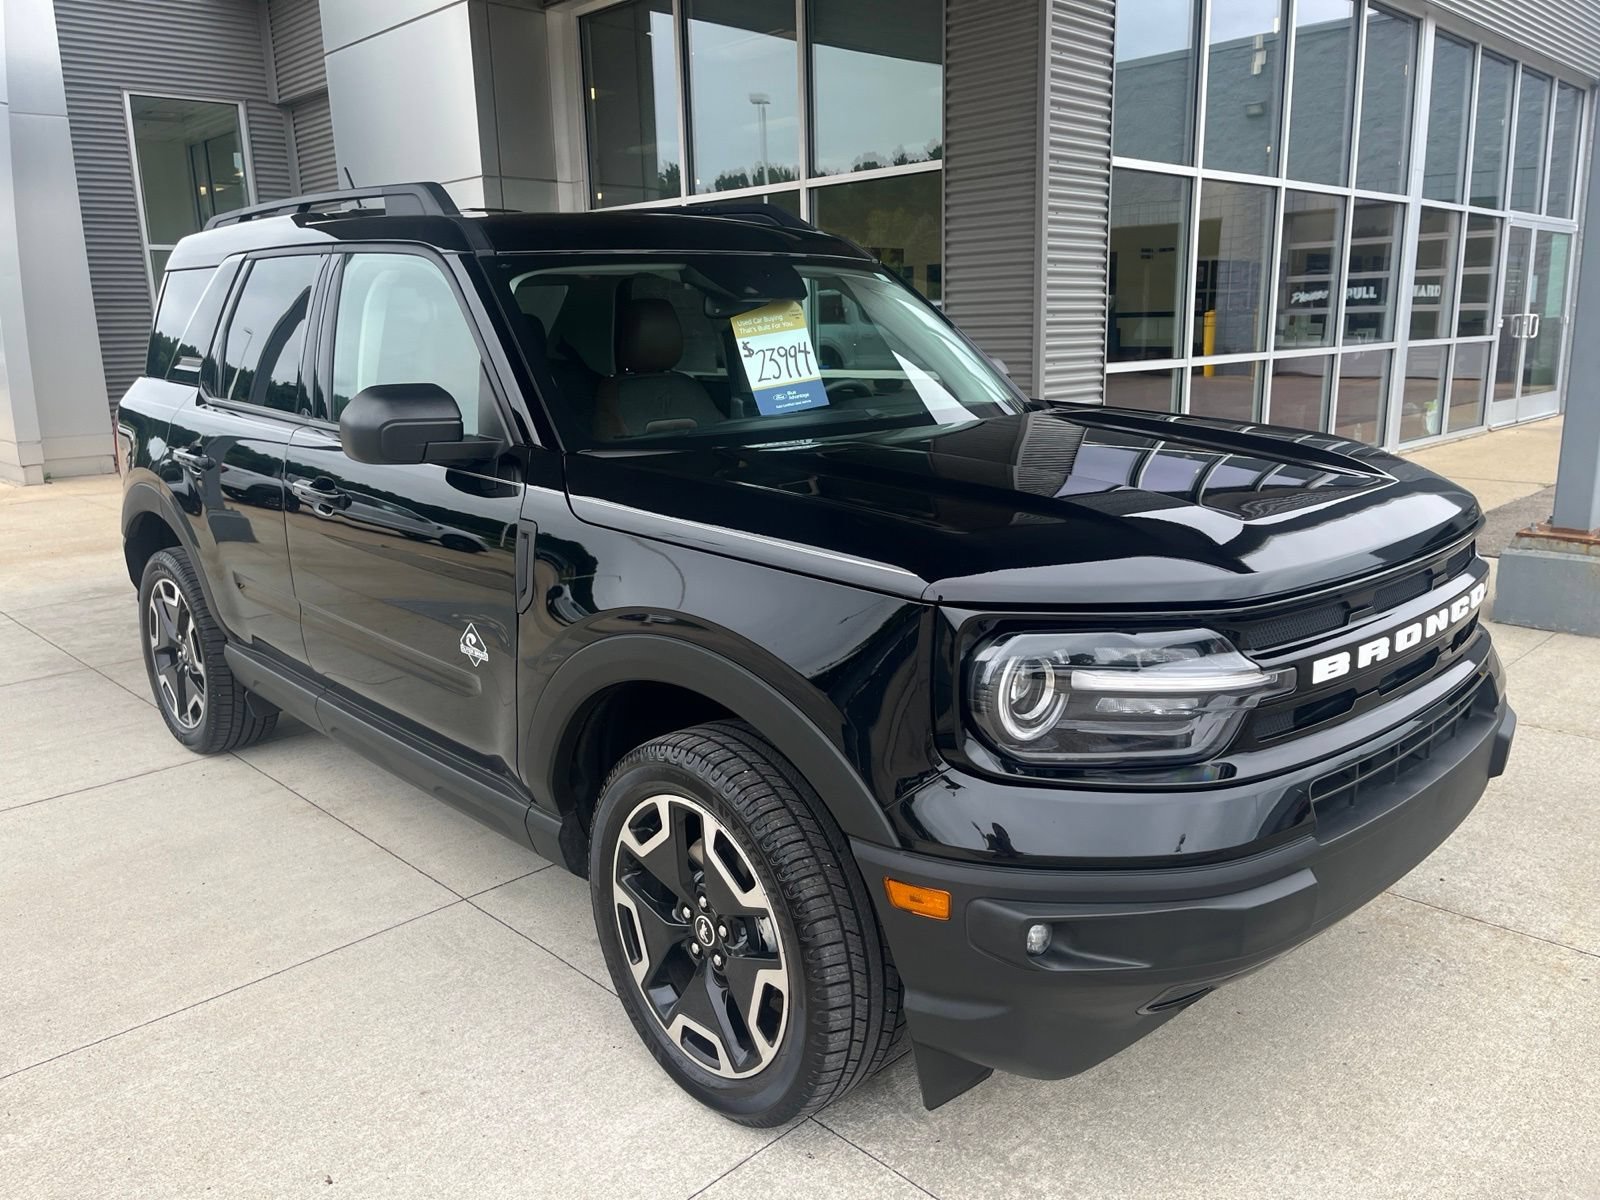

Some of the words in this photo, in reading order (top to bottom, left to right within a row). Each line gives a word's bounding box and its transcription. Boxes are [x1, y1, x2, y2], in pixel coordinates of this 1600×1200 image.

[1290, 290, 1329, 304] Please
[1346, 286, 1377, 300] PULL
[737, 319, 753, 327] Used
[763, 314, 784, 323] Buying
[739, 326, 757, 334] That's
[1312, 582, 1486, 684] BRONCO
